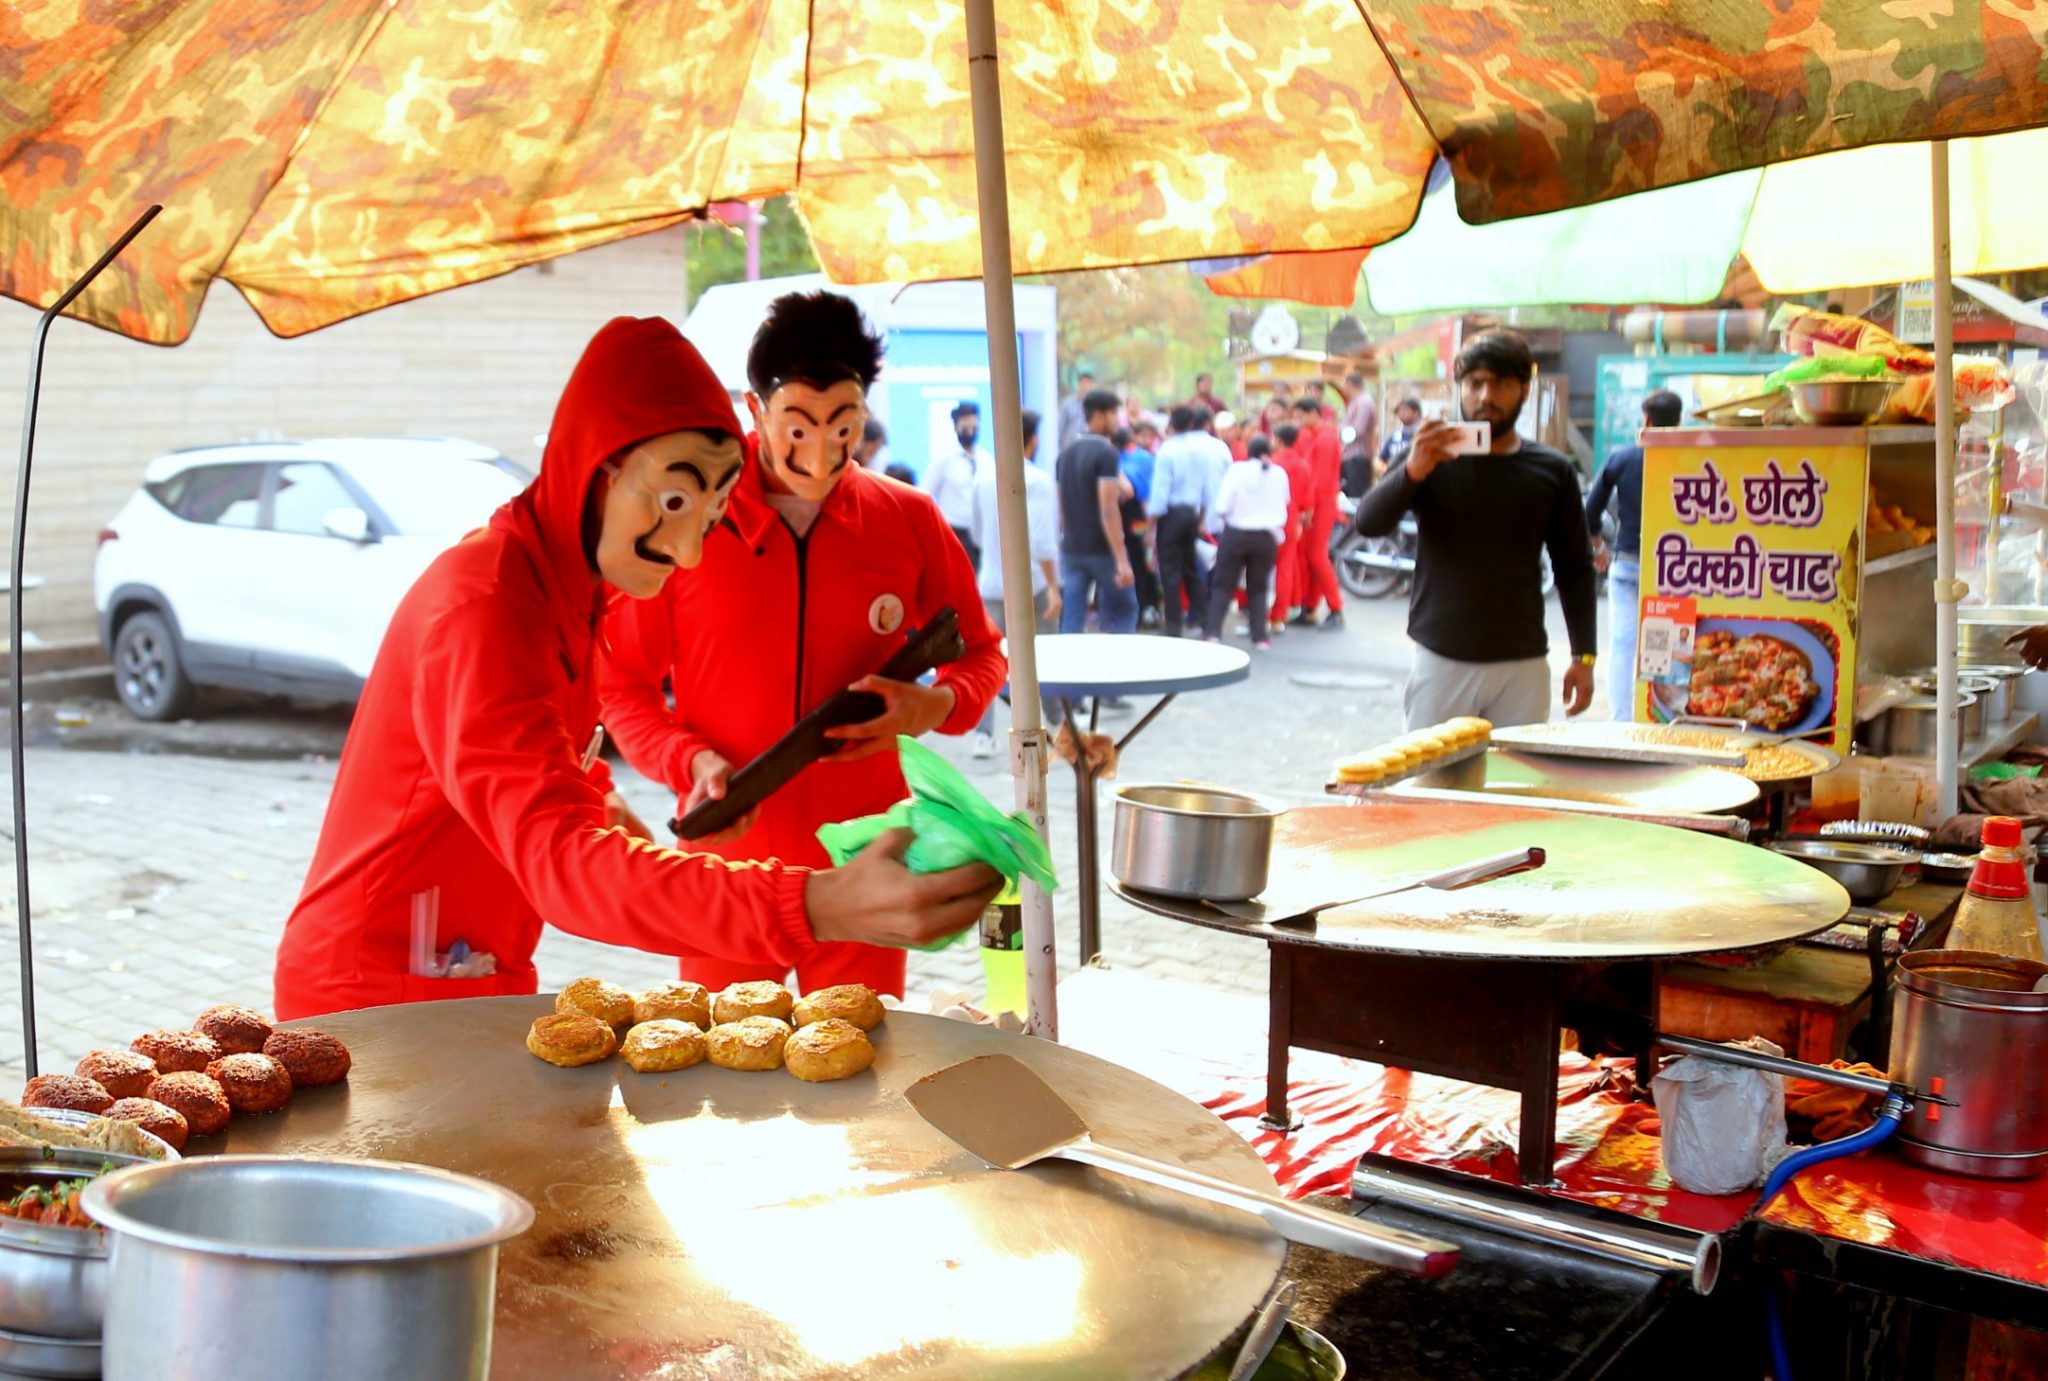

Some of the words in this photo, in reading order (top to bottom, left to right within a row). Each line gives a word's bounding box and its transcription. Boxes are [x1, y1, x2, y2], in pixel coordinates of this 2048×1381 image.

[1673, 461, 1732, 518] स्पे.
[1743, 461, 1823, 520] छोले
[1656, 533, 1761, 592] टिक्की
[1768, 552, 1836, 595] चाट
